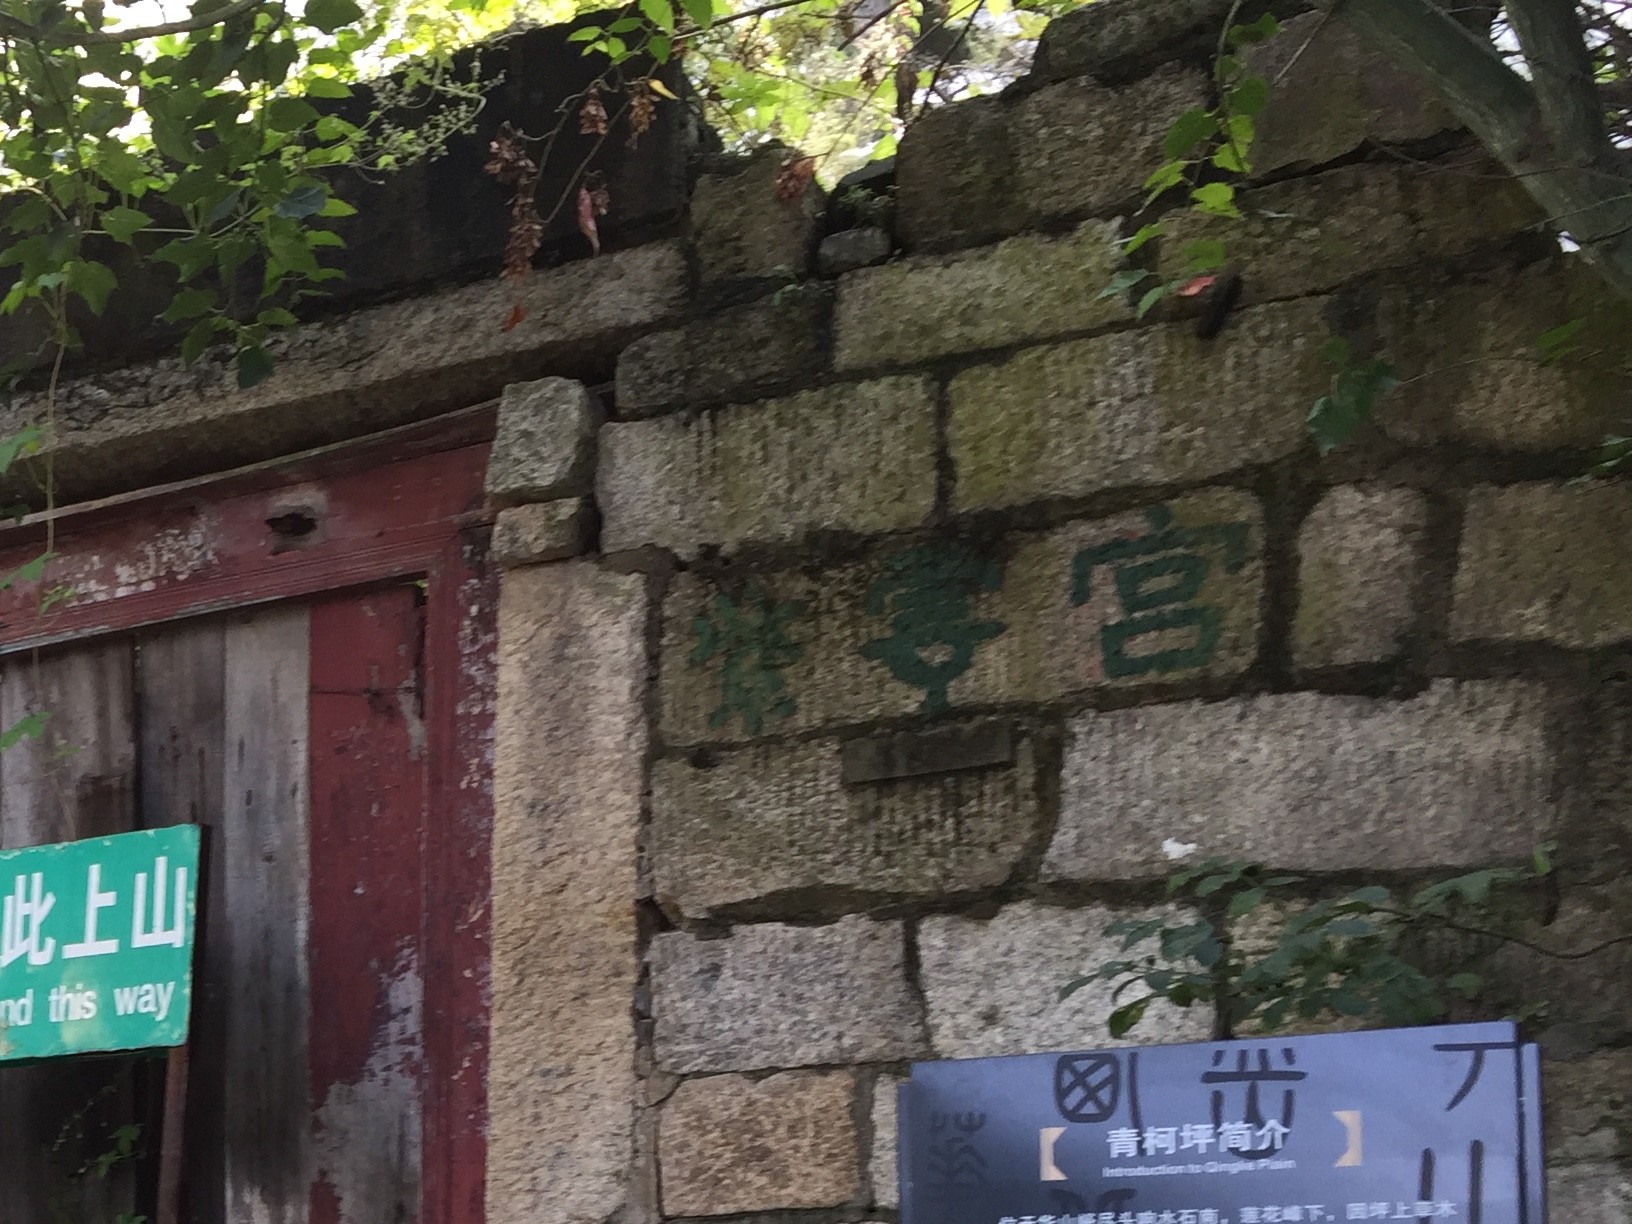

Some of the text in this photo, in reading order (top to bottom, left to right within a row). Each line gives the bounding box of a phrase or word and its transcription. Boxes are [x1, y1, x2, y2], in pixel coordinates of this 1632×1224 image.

[49, 983, 97, 1023] this
[114, 981, 175, 1020] way
[1106, 1119, 1290, 1159] 青柯坪简介
